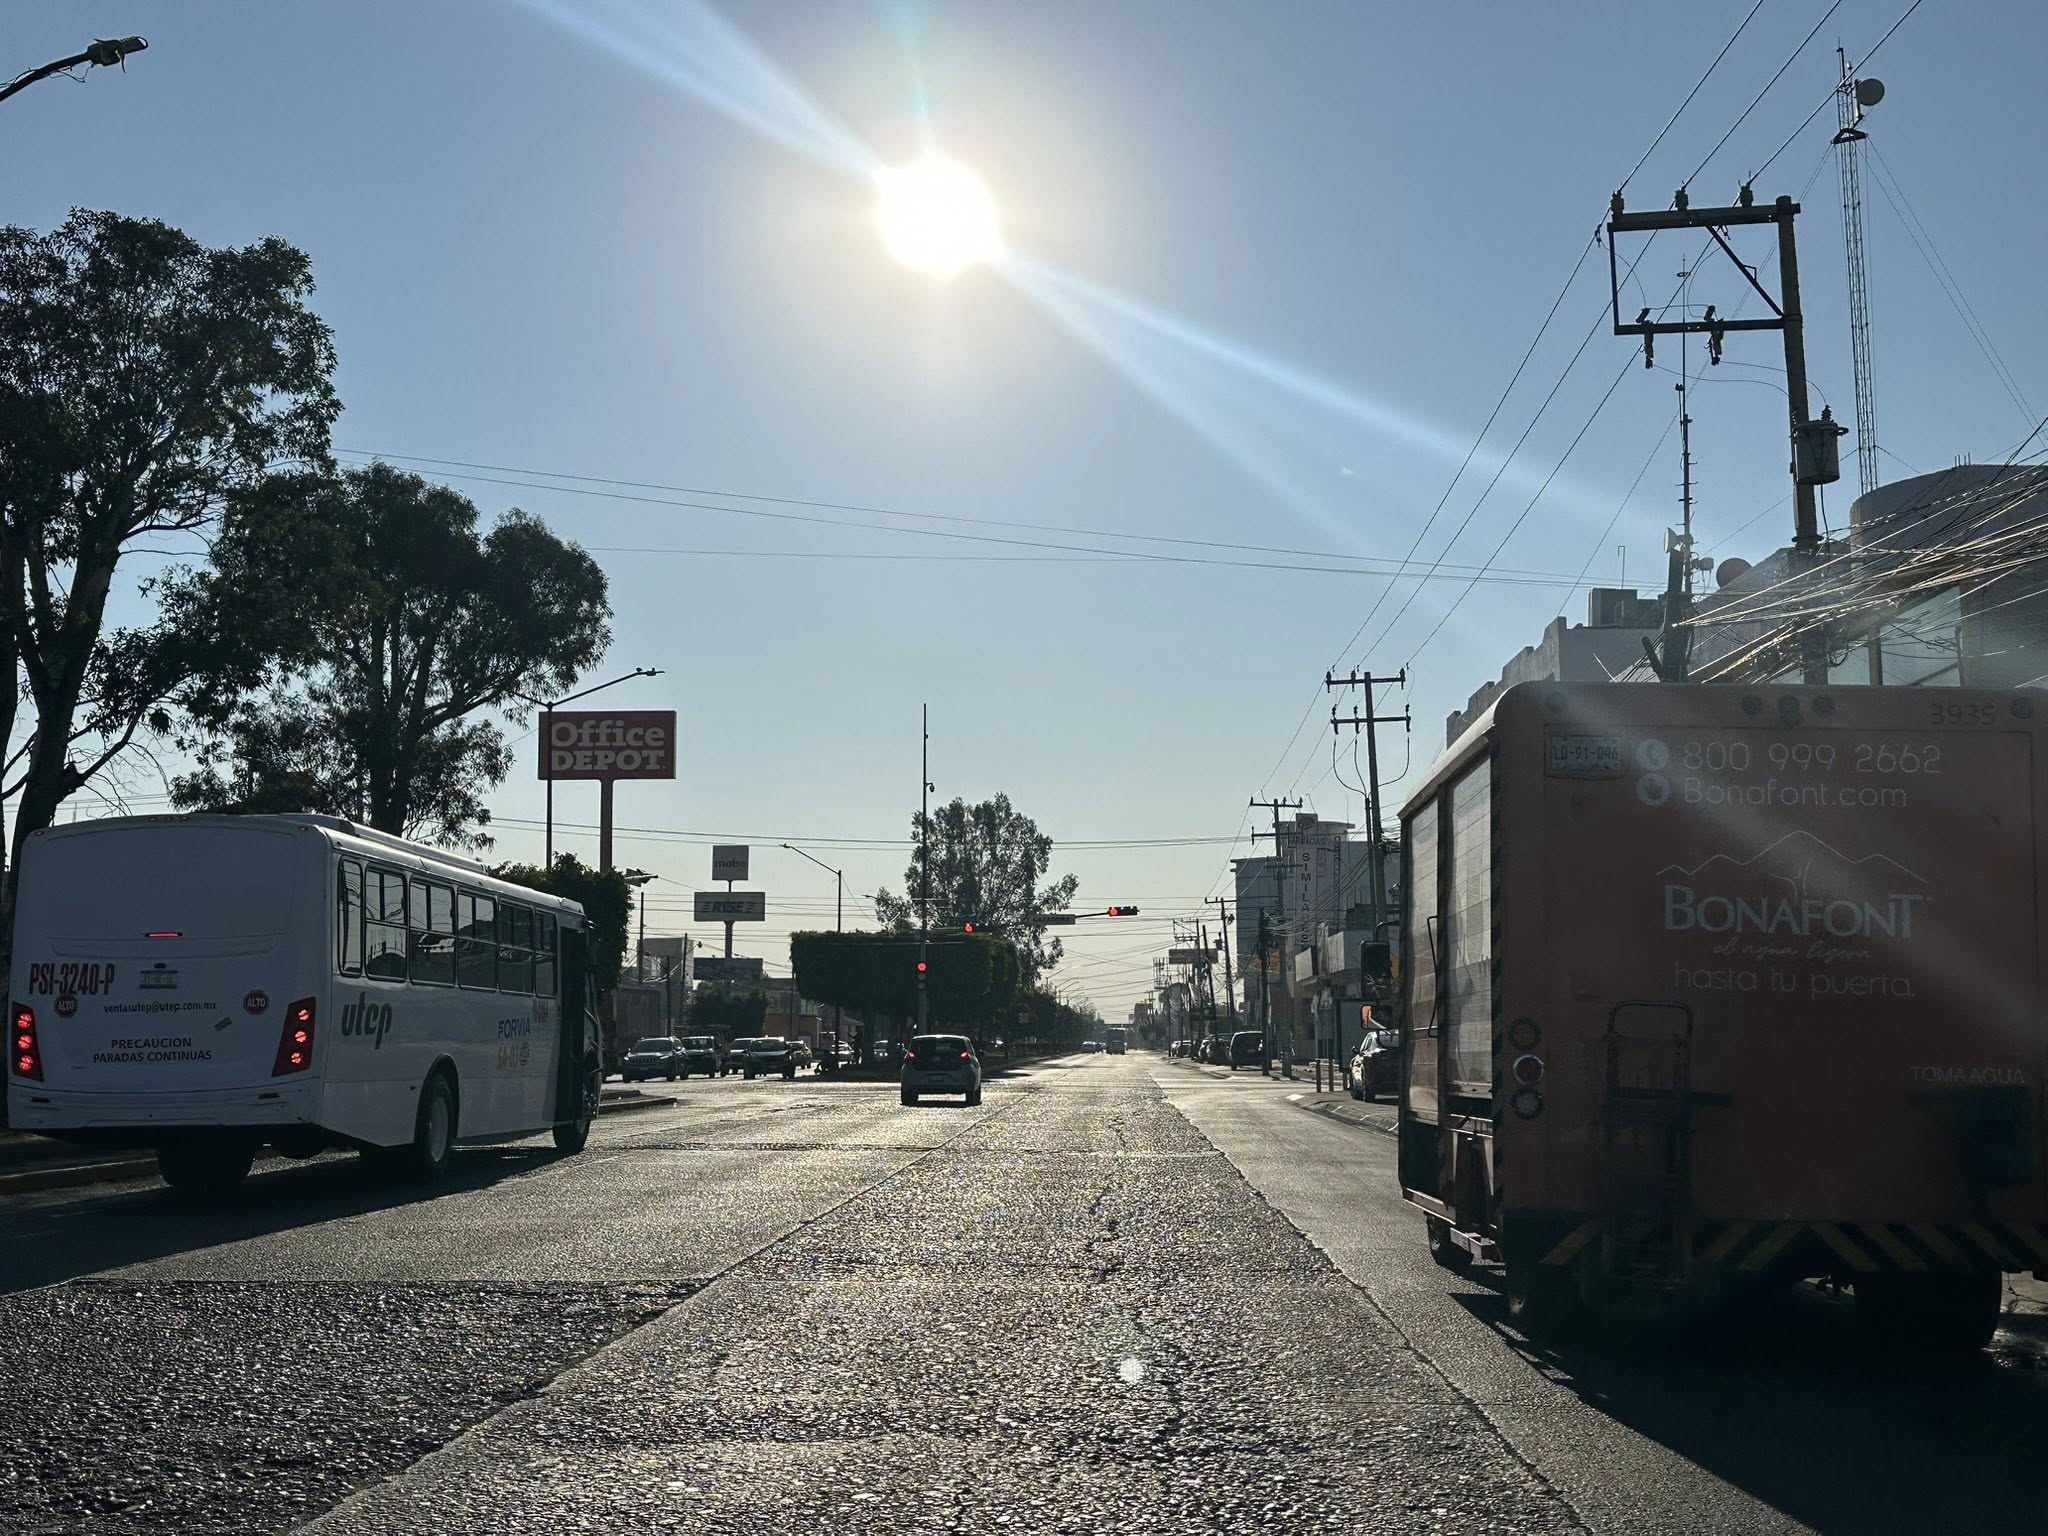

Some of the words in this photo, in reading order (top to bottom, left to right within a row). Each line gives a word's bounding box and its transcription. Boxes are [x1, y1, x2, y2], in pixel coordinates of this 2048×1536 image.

[552, 720, 665, 747] Office
[552, 749, 666, 771] DEPOT
[1683, 742, 1750, 771] 800
[1768, 743, 1835, 772] 999
[1855, 744, 1941, 774] 2662
[1683, 777, 1907, 808] Bonafont.com
[1300, 852, 1312, 943] SIMILAES
[1664, 884, 1921, 939] BONAFONT
[28, 962, 115, 995] PSI-3240-P
[1674, 960, 1758, 992] hasta
[1770, 966, 1797, 993] tu
[104, 1001, 217, 1014] ventasutep@utep.com.mx
[246, 998, 266, 1007] ALTO
[341, 992, 393, 1050] utep
[497, 1017, 531, 1039] FORVIA
[93, 1051, 144, 1064] PARADAS
[147, 1050, 212, 1062] CONTINUAS
[111, 1037, 192, 1049] PRECAUCION
